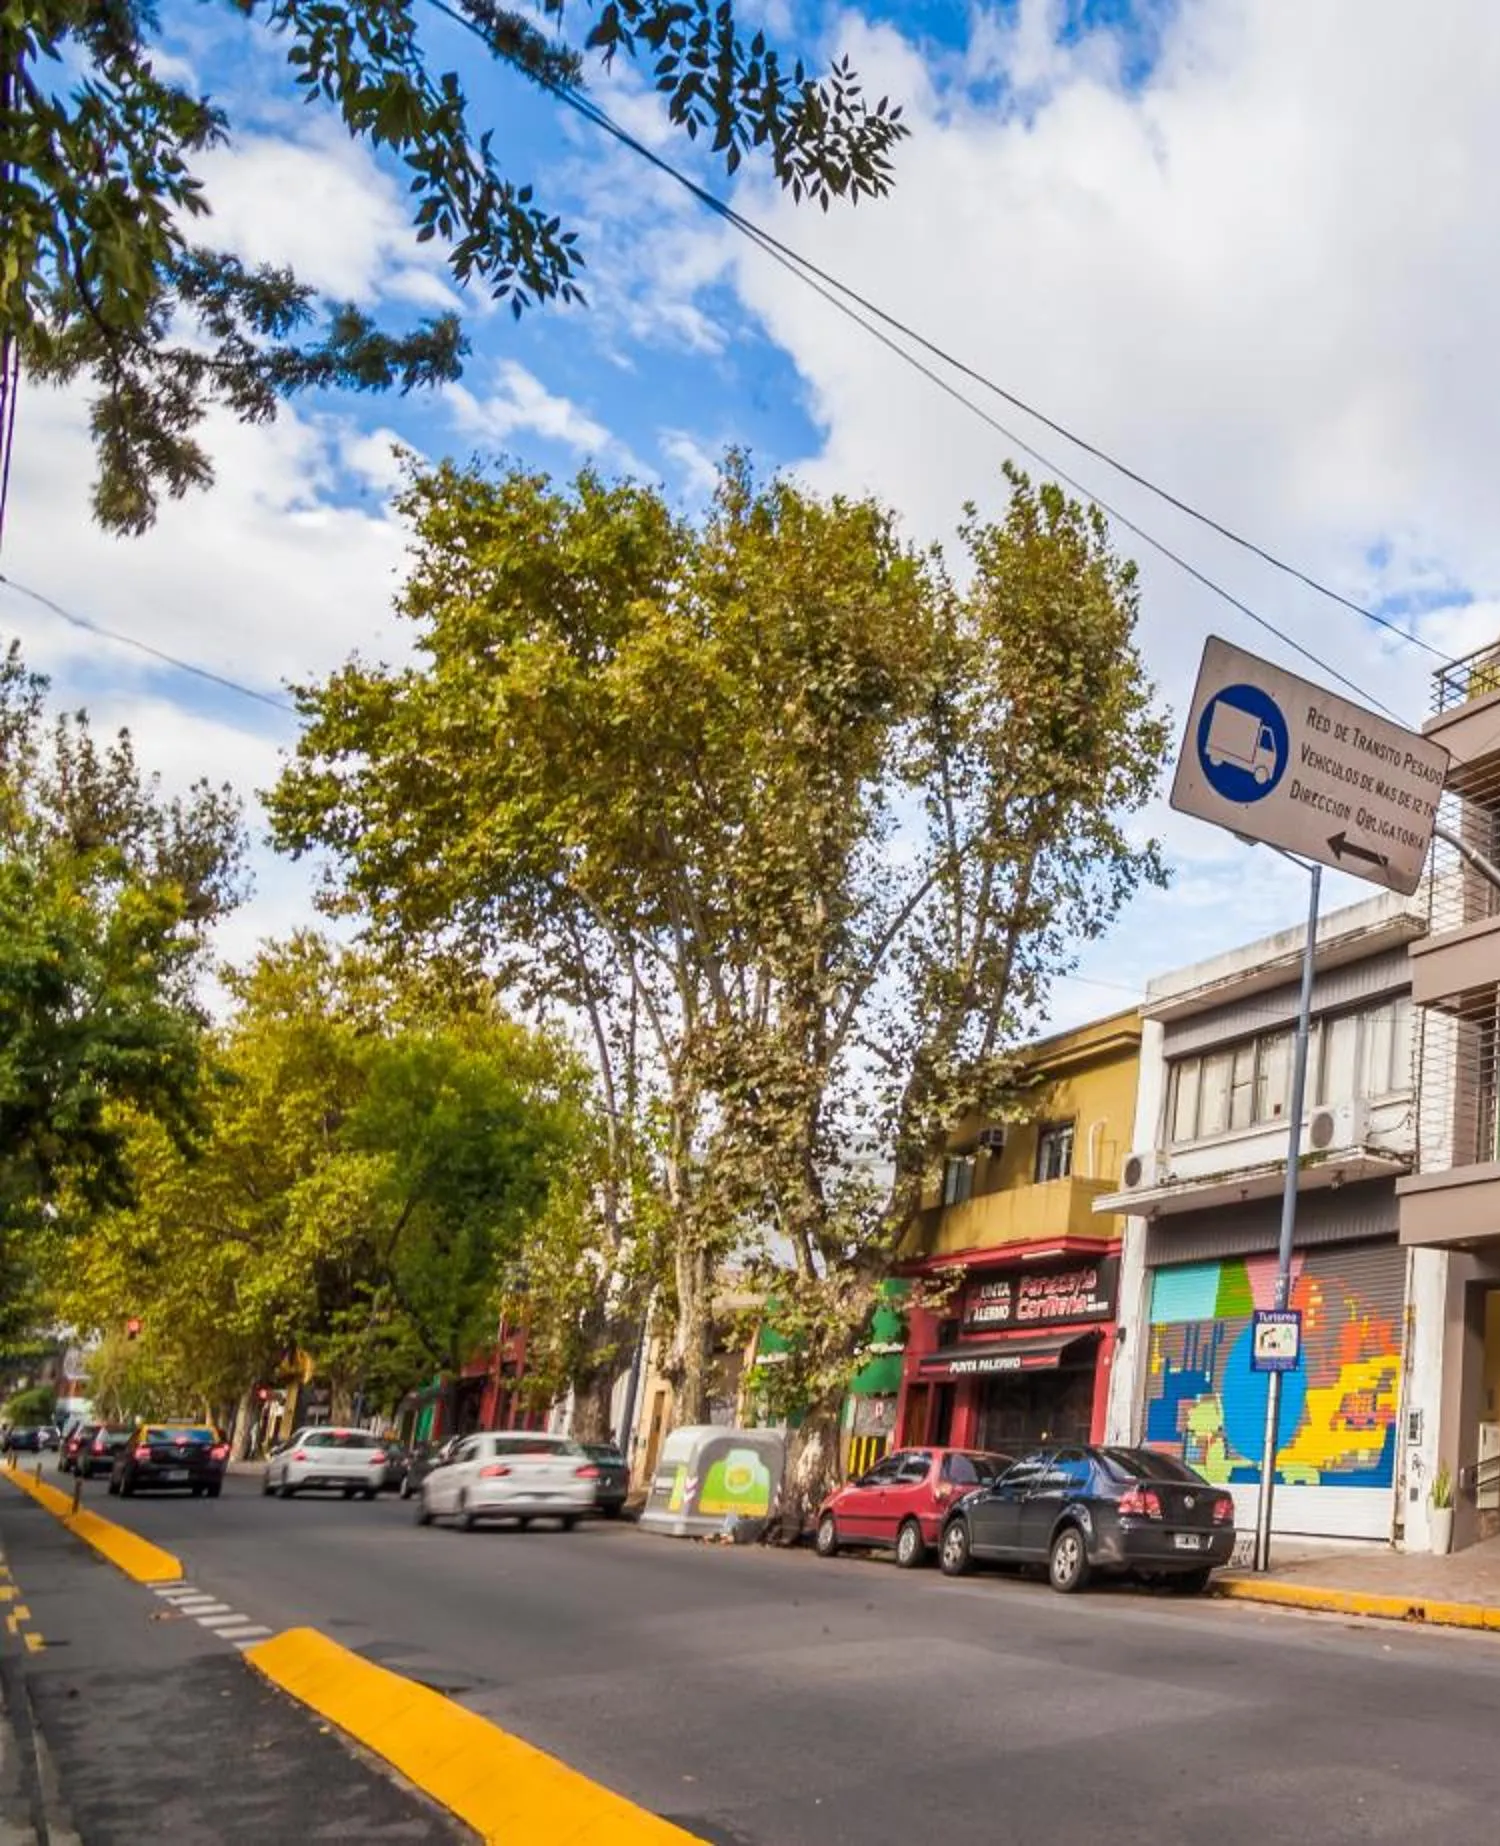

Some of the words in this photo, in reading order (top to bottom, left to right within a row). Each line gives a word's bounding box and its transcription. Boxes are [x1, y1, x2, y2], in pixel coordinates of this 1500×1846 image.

[1333, 722, 1350, 743] DE
[1352, 727, 1401, 767] TRANSITO
[1403, 752, 1443, 785] PESADO
[1359, 773, 1375, 793] DE
[1289, 778, 1351, 820] DIRECCION
[1355, 807, 1425, 849] OBLIGATORIA
